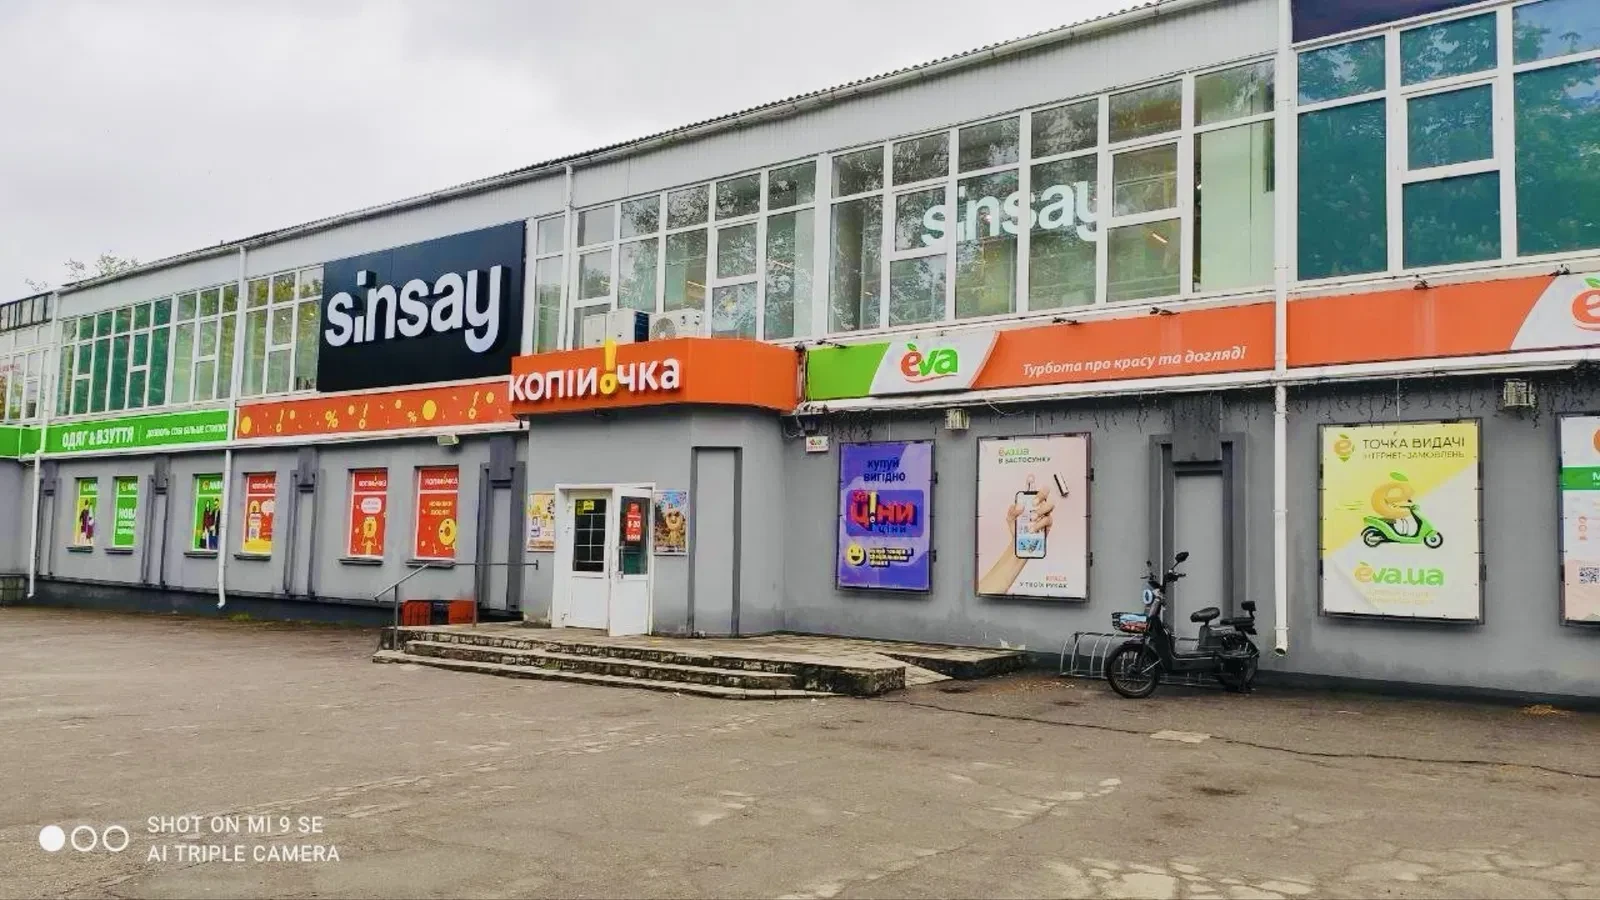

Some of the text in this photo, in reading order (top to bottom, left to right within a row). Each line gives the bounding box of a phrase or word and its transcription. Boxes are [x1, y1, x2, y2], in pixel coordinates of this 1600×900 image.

[921, 181, 1098, 246] sinsay
[325, 265, 502, 354] sinsay
[1022, 346, 1248, 378] Турбота про красу та догляд!
[62, 431, 86, 450] ОДЯГ
[97, 426, 135, 445] ВЗУТТЯ
[1362, 437, 1465, 449] ТОЧКА ВИДАЧІ
